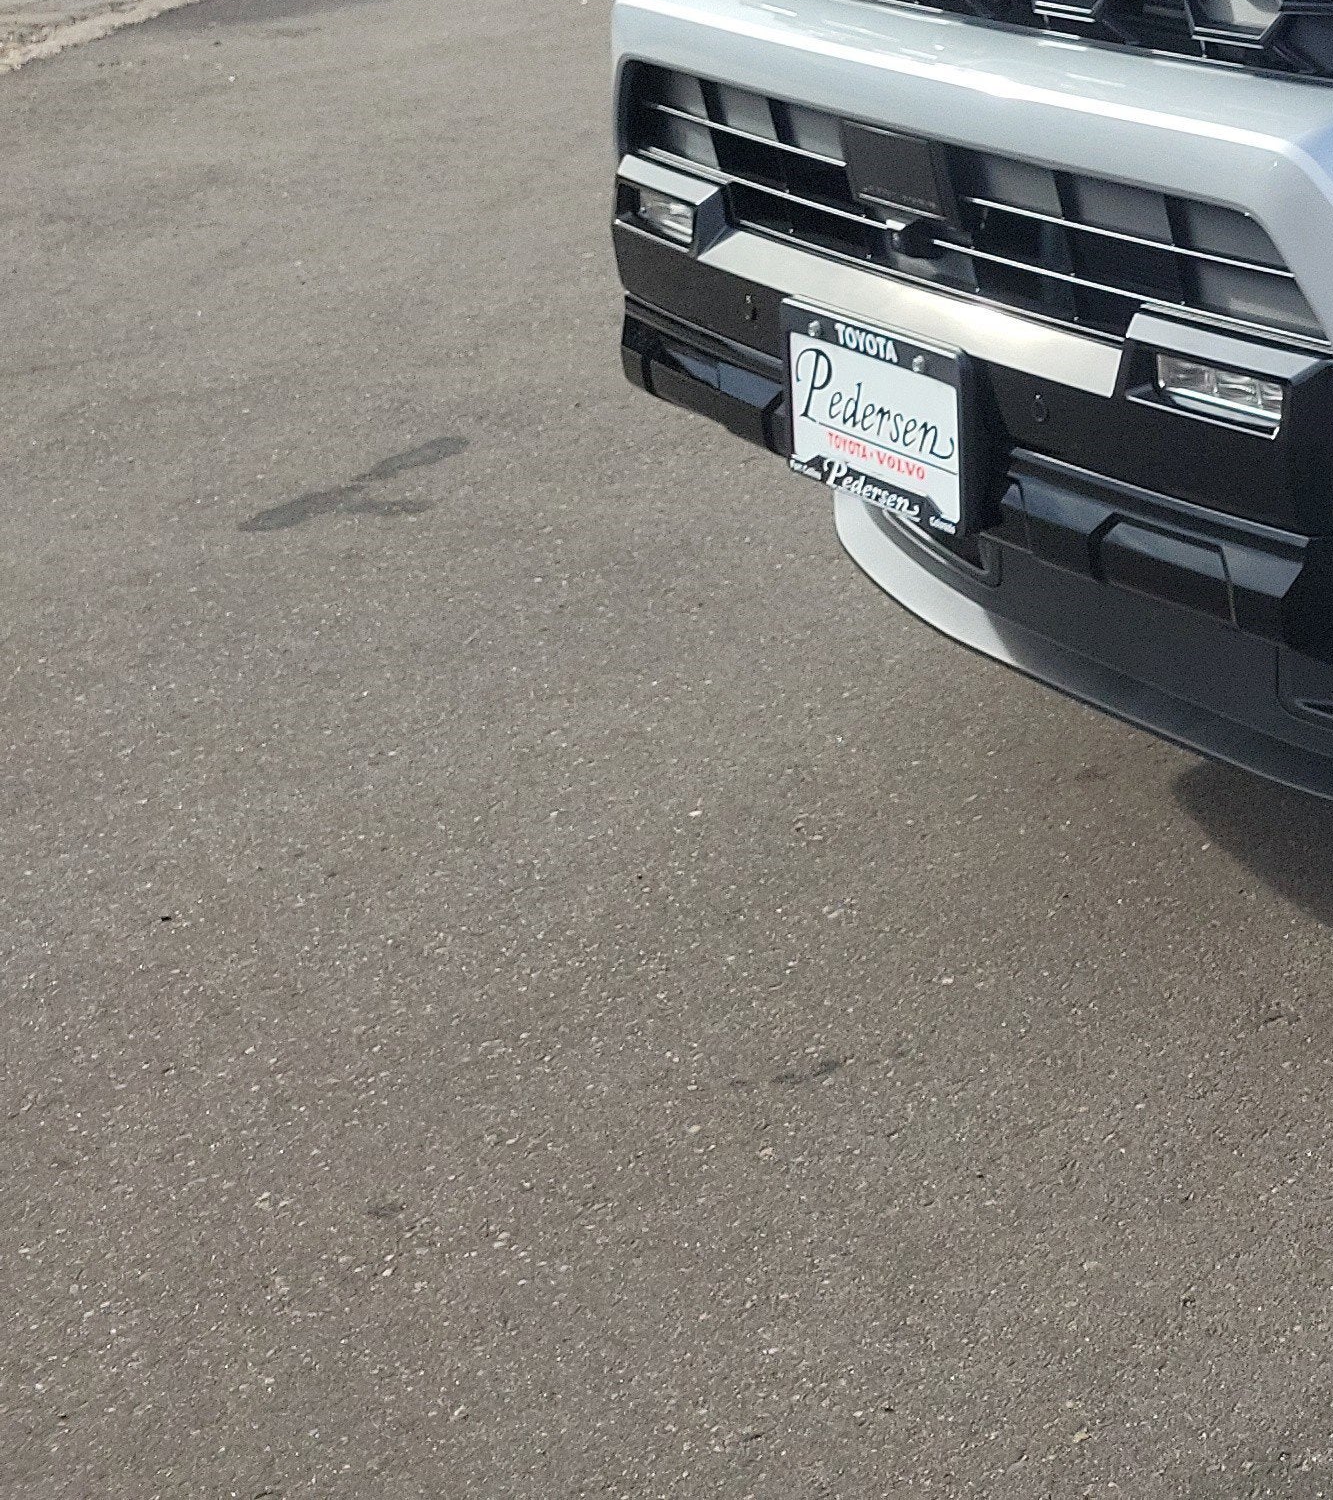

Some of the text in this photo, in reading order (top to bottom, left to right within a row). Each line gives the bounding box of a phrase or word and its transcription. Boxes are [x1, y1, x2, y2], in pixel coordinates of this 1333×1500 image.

[834, 322, 898, 363] TOYOTA
[796, 348, 955, 460] Pedersen
[822, 457, 921, 517] Pedersen
